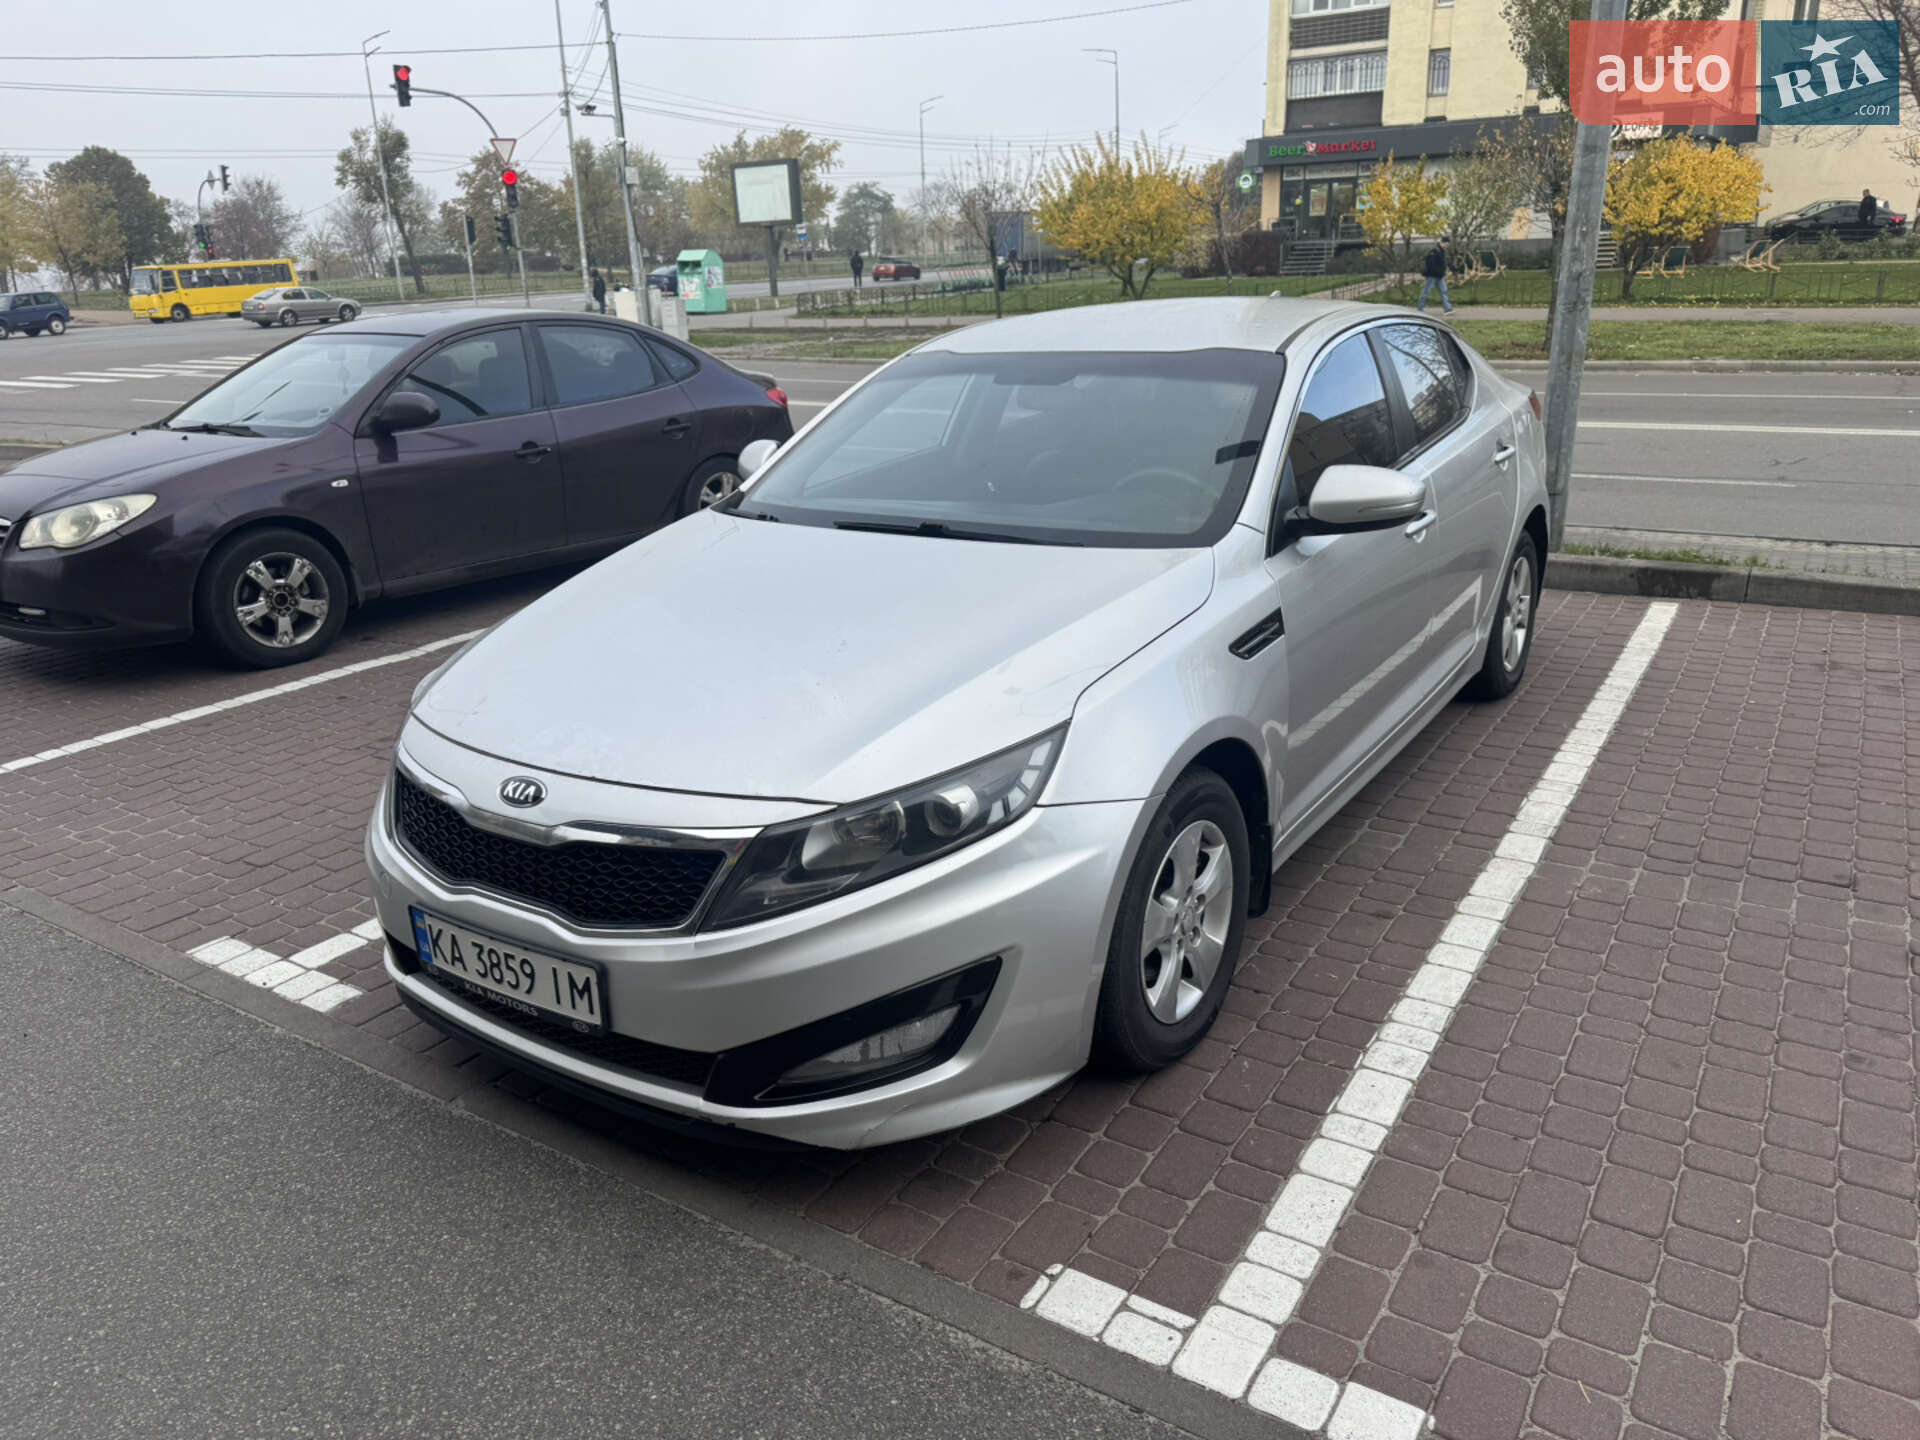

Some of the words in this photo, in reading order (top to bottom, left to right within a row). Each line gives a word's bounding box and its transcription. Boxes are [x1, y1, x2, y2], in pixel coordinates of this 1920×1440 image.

[503, 780, 536, 802] KIA
[428, 923, 468, 972] KA
[471, 941, 536, 995] 3859
[551, 966, 595, 1015] IM
[463, 981, 485, 996] KIA
[487, 990, 539, 1017] MOTORS
